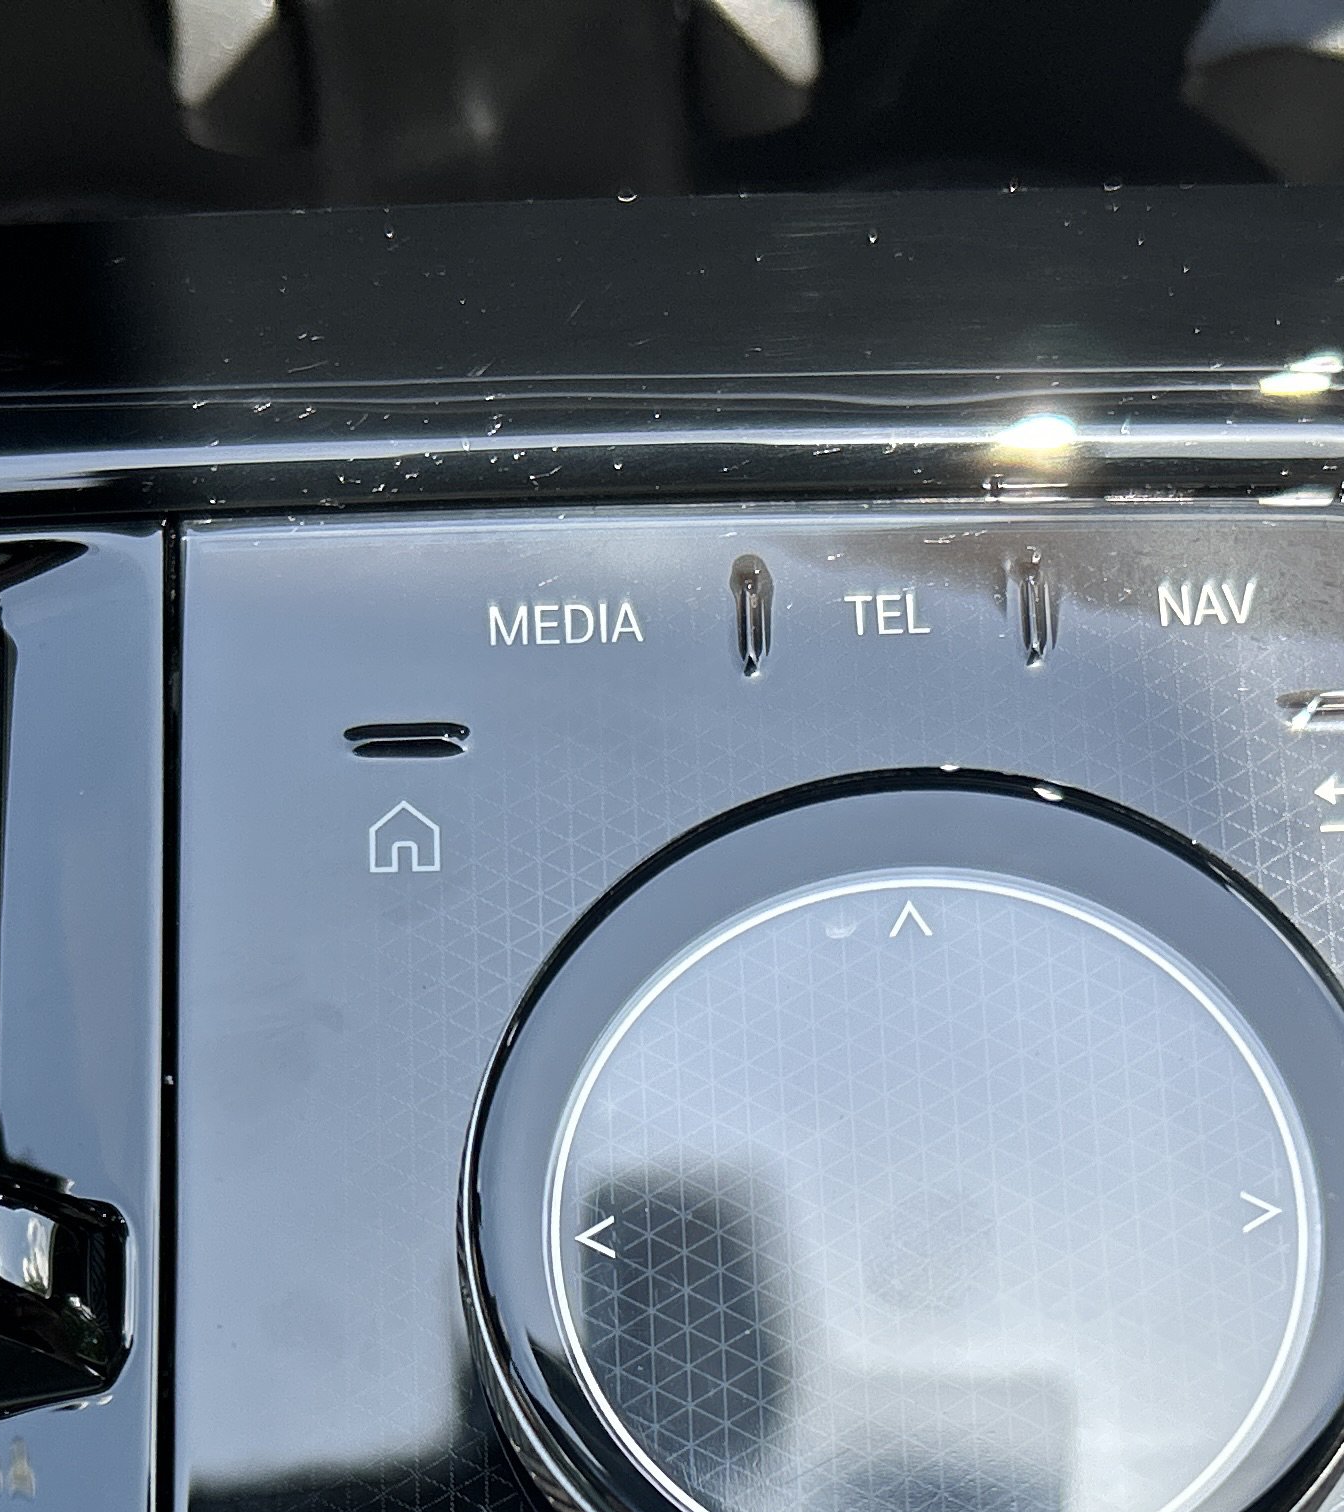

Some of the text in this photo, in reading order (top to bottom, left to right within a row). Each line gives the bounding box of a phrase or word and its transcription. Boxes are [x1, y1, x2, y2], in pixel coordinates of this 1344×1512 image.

[487, 602, 644, 648] MEDIA
[844, 593, 931, 637] TEL
[1158, 581, 1257, 627] NAV
